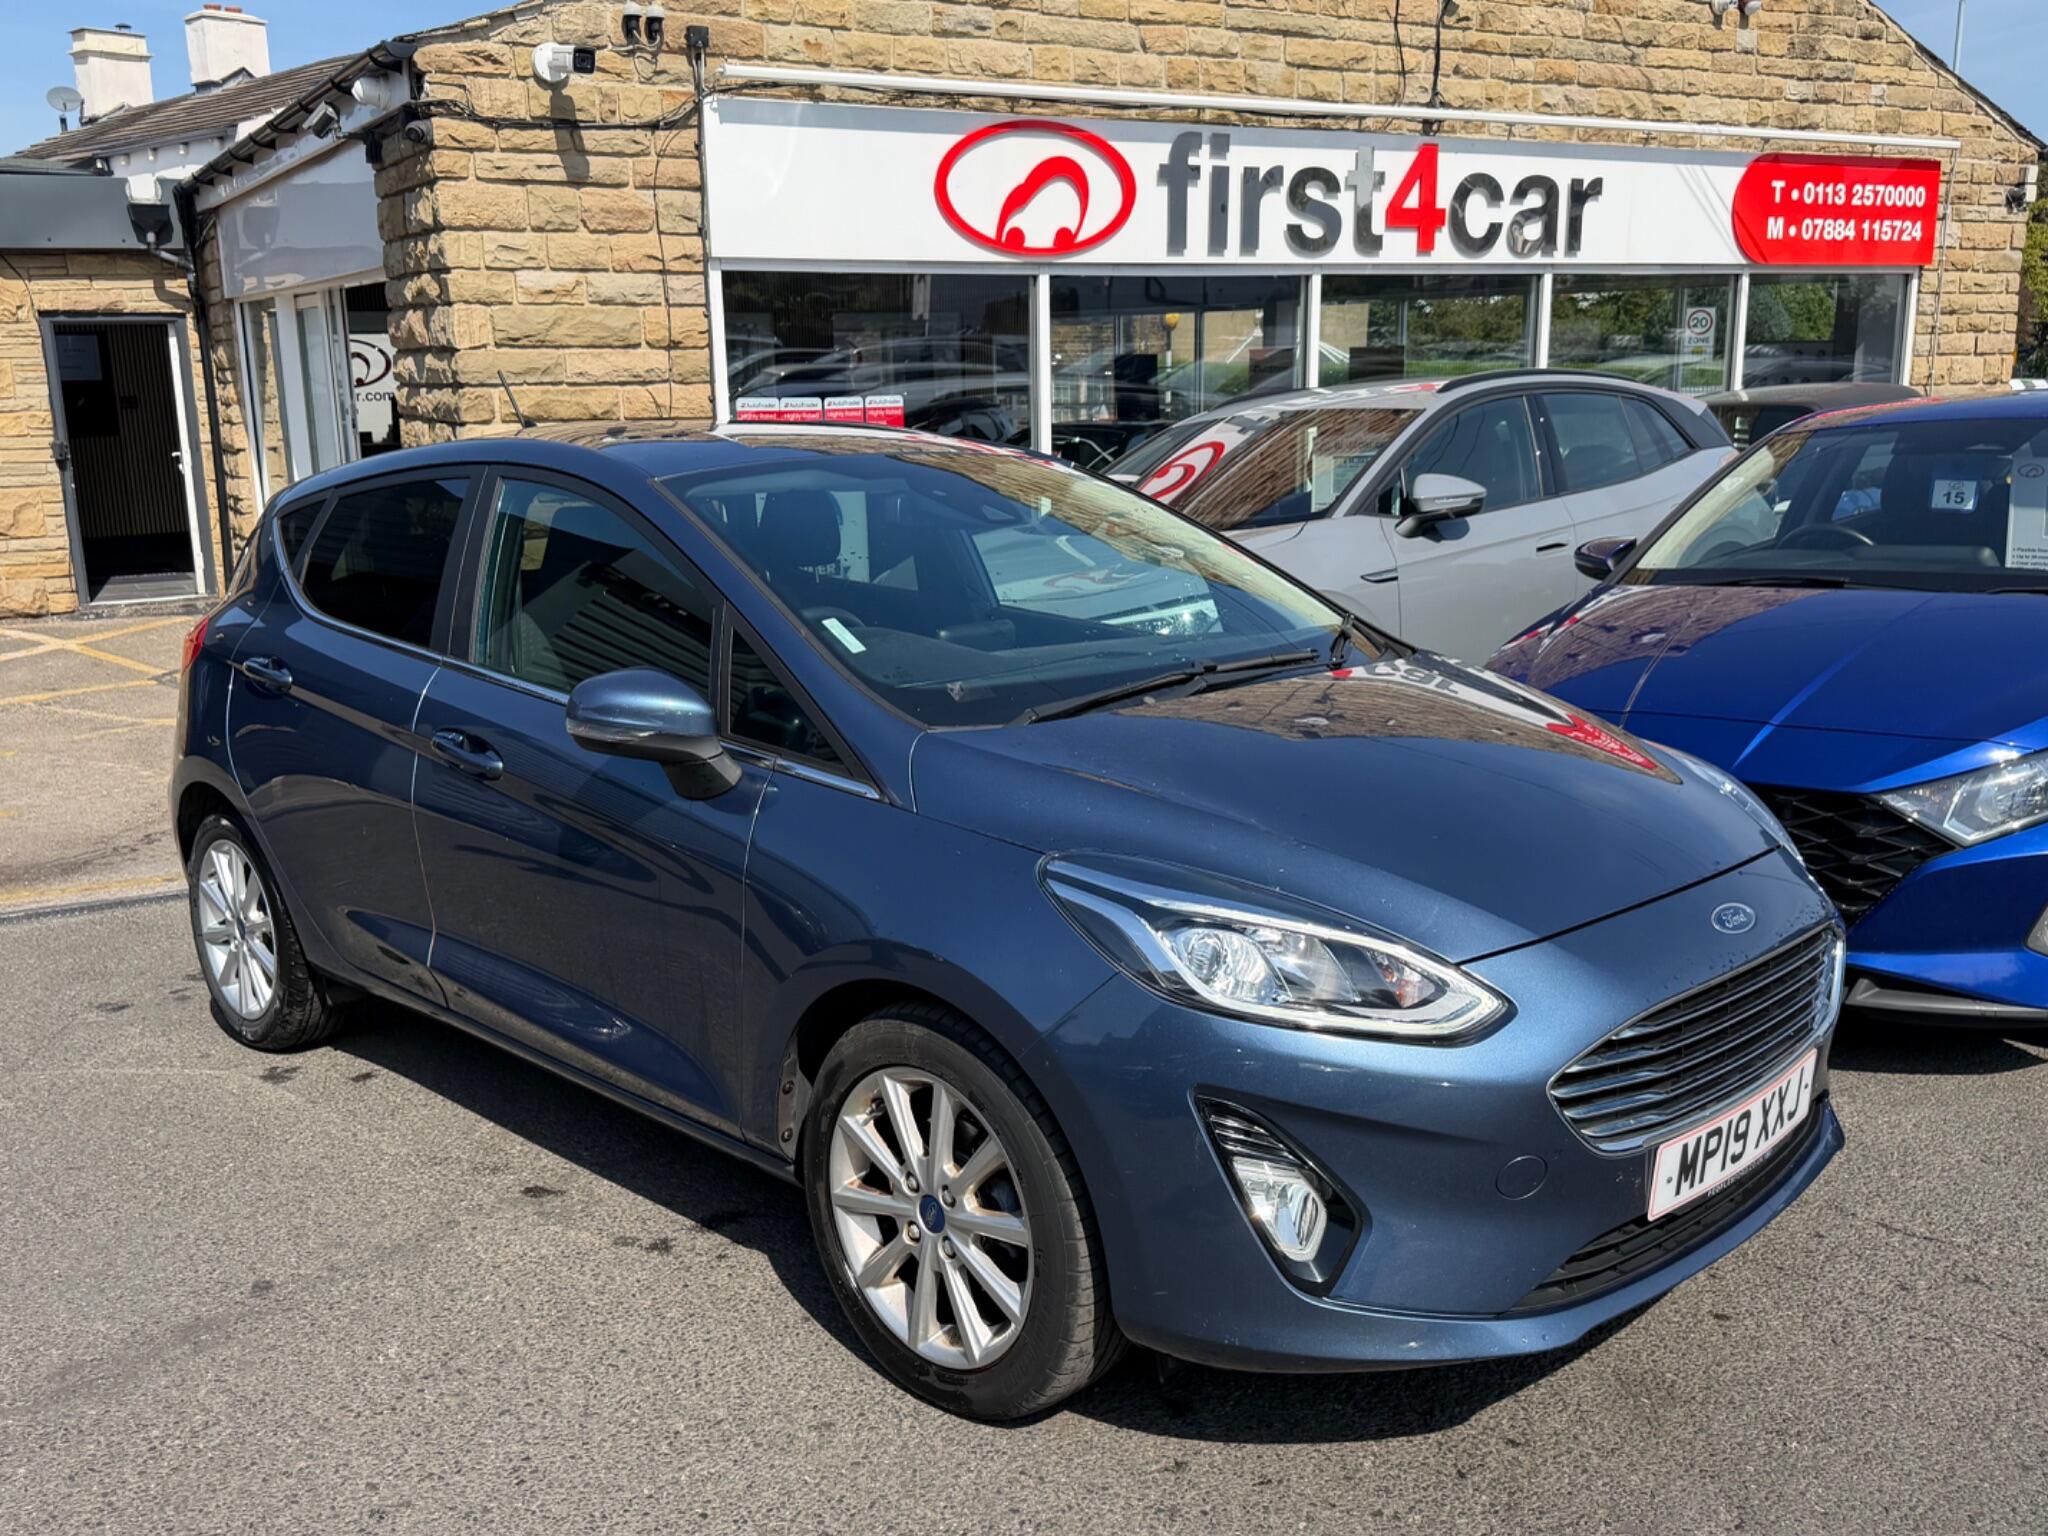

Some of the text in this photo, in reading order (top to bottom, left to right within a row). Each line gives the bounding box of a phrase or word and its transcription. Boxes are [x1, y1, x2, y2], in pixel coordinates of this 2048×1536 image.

[1157, 131, 1604, 258] first4car
[1771, 180, 1926, 207] T 0113 2570000
[1766, 216, 1922, 241] M 07884 115724
[1691, 316, 1709, 328] 20
[1943, 491, 1966, 505] 15
[1674, 1109, 1752, 1198] MP19
[1754, 1066, 1805, 1150] XXJ
